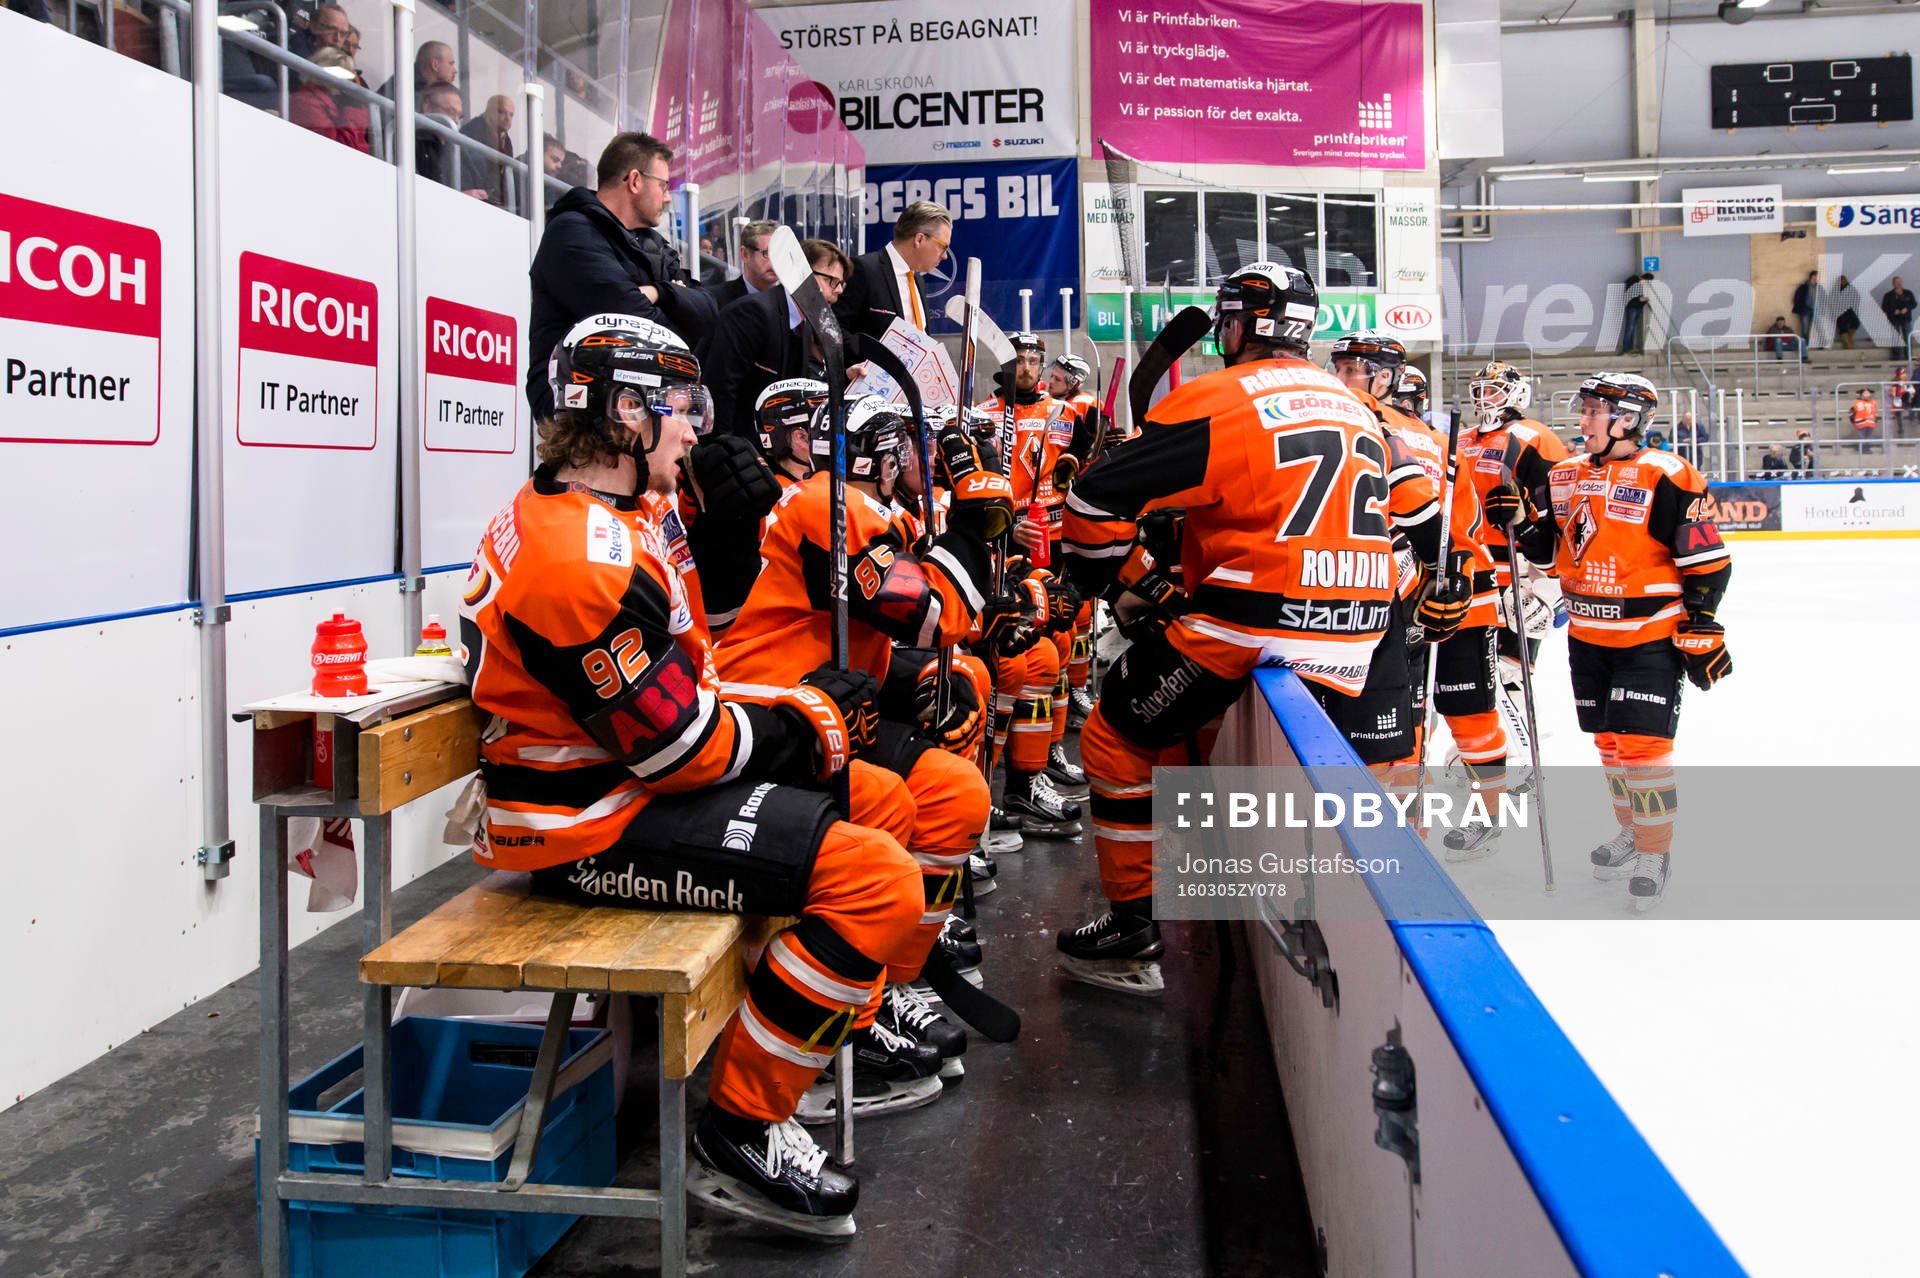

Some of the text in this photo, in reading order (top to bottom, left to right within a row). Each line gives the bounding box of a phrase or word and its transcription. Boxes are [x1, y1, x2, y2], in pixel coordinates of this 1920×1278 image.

[780, 16, 1038, 49] STÖRST PÅ BEGAGNAT!
[1119, 10, 1241, 28] Vi är Printfabriken.
[1119, 41, 1230, 60] Vi är tryckglädje.
[838, 75, 934, 92] KARLSKRONA
[1119, 72, 1312, 93] Vi är det matematiska hjärtat.
[839, 88, 1044, 131] BILCENTER
[1120, 103, 1302, 122] Vi är passion för det exakta.
[946, 138, 1044, 149] mazda SUZUKI
[825, 175, 1060, 225] BERGS BIL
[1095, 196, 1126, 209] DÅLIGT
[1716, 197, 1775, 214] HENKES
[1087, 211, 1135, 224] MED MÅL?
[1390, 216, 1430, 227] MASSOR.
[0, 230, 146, 305] ICOH
[251, 281, 369, 342] RICOH
[1808, 253, 1920, 348] K
[1098, 312, 1120, 326] BIL
[1284, 320, 1306, 338] 72
[1393, 314, 1424, 325] KIA
[433, 319, 511, 366] RICOH
[6, 358, 130, 401] Partner
[260, 381, 359, 416] IT Partner
[439, 400, 504, 427] IT Partner
[1003, 405, 1014, 480] UPREME
[1274, 426, 1391, 542] 72
[1553, 471, 1577, 482] SAVE
[1709, 494, 1768, 523] AND
[1805, 504, 1905, 519] Hotell Conrad
[836, 479, 848, 602] NEXUS
[1688, 523, 1723, 550] AB
[1300, 549, 1390, 590] ROHDIN
[1279, 599, 1390, 631] stadium
[325, 652, 363, 664] ENERVIT
[582, 627, 651, 699] 92
[1131, 667, 1193, 724] Sweden
[1440, 681, 1476, 693] Roxtec
[1626, 690, 1667, 705] Roxtec
[609, 662, 698, 754] ABB
[987, 686, 997, 737] BAUER
[1351, 729, 1403, 741] printfabriken
[568, 857, 744, 912] Sweden Rock
